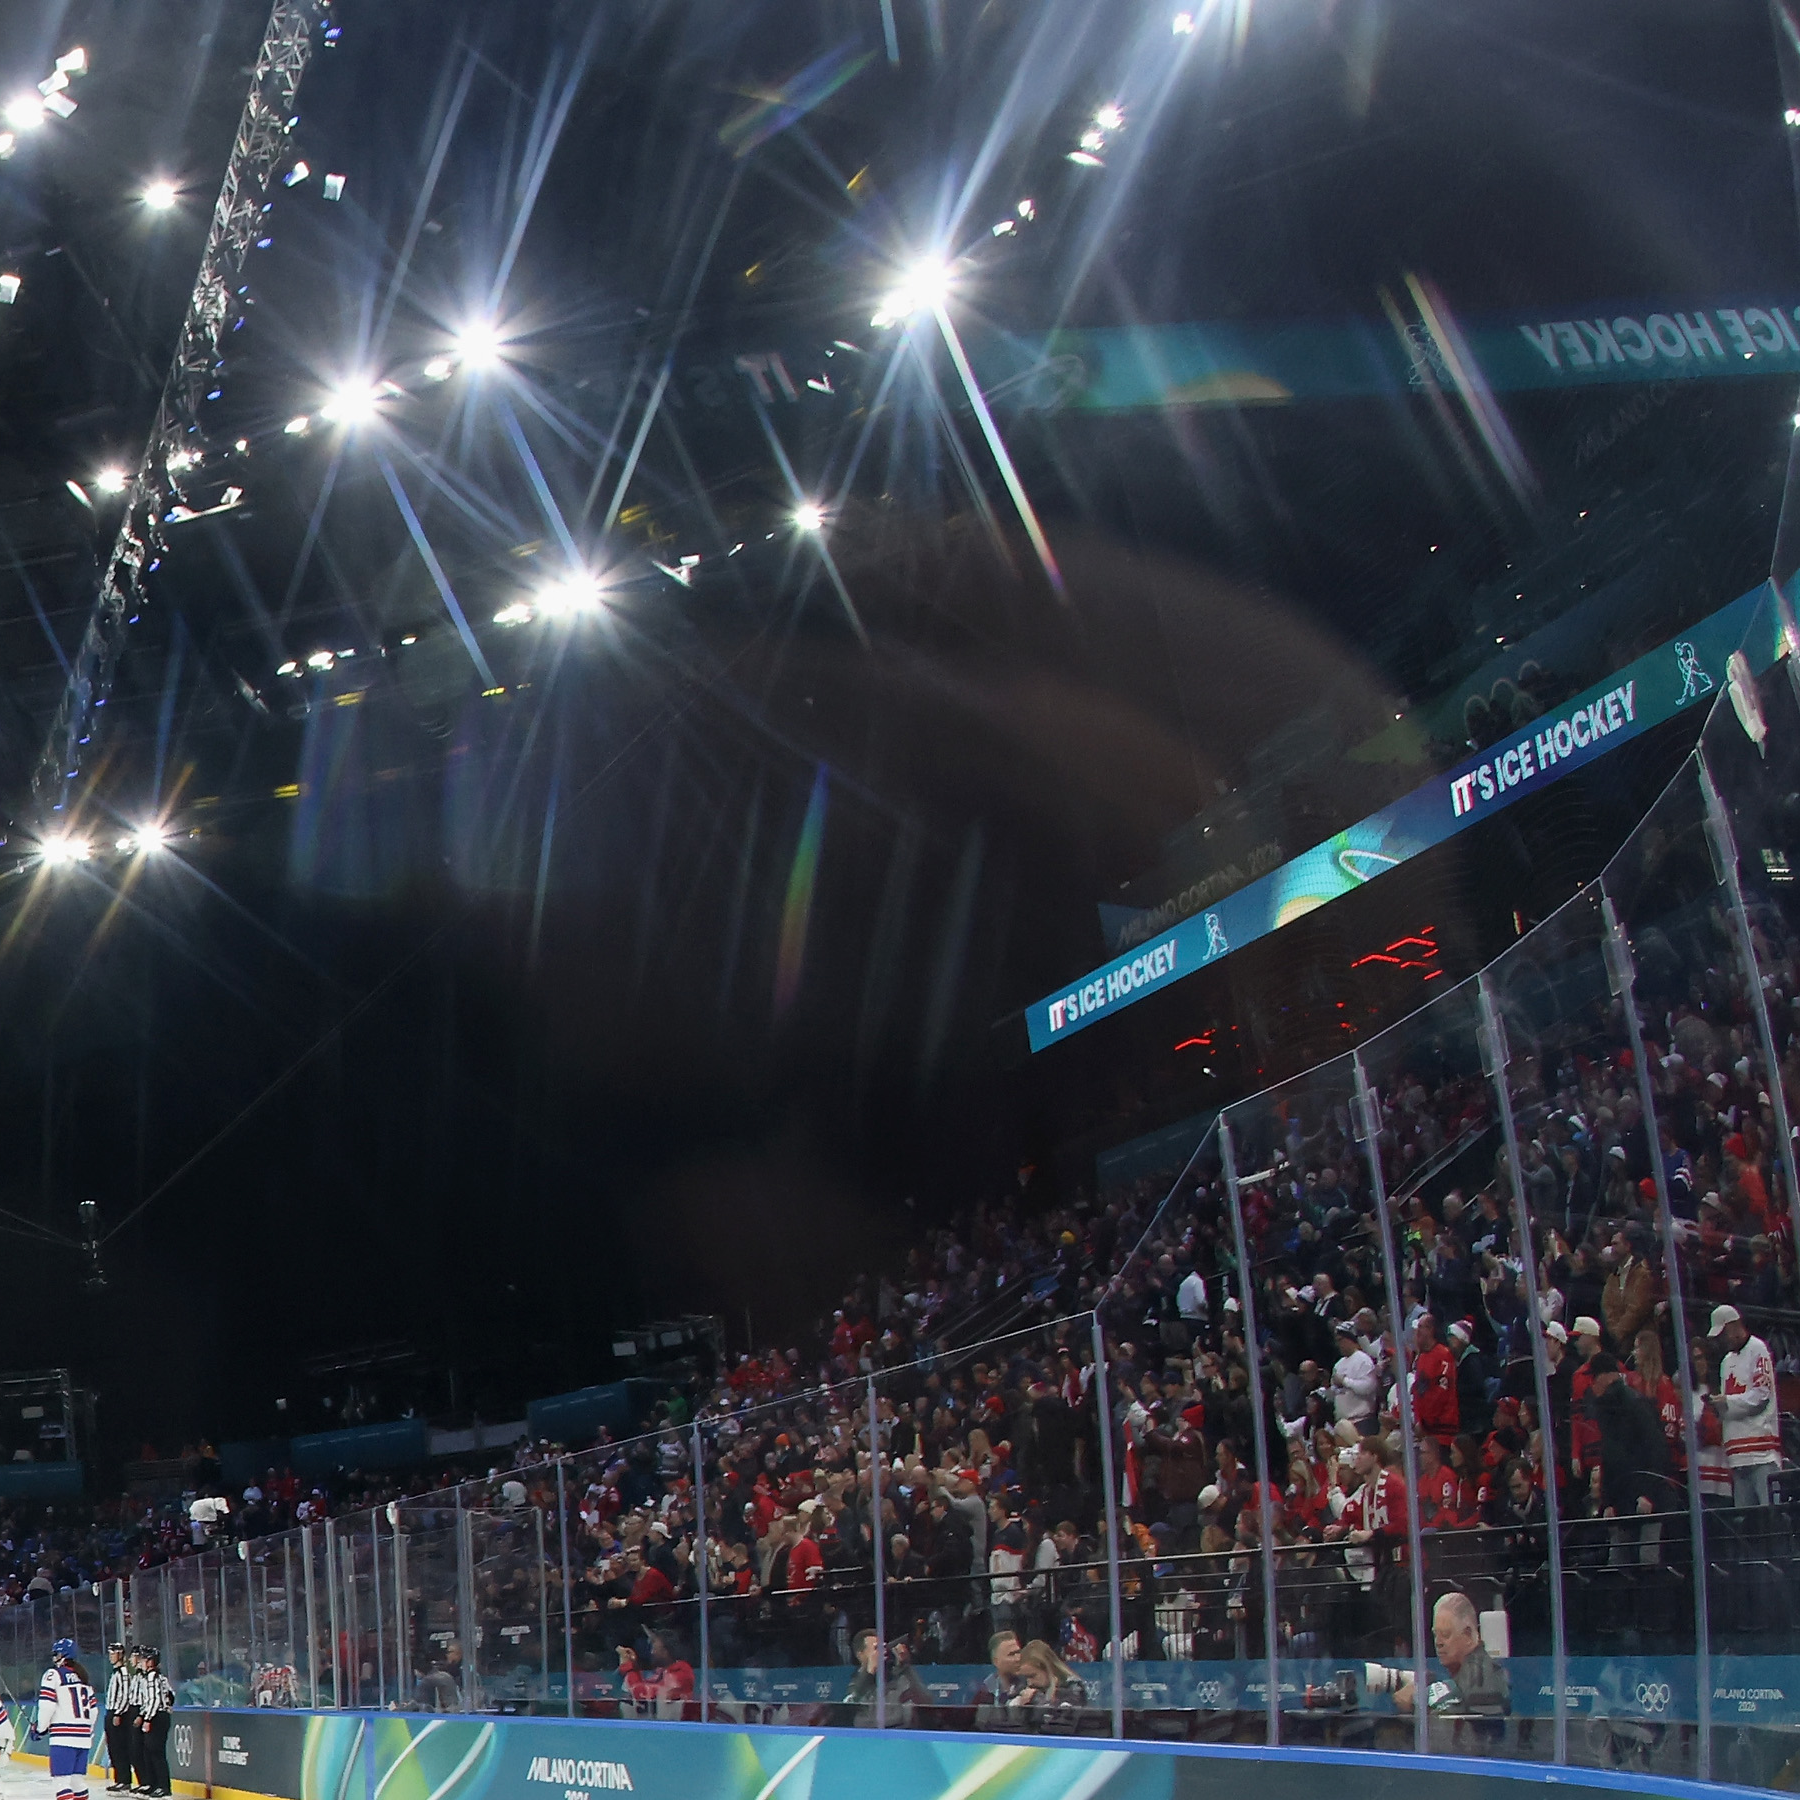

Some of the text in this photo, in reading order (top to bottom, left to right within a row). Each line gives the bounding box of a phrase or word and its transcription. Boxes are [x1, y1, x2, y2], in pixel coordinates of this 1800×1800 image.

[1451, 680, 1637, 818] IT'S ICE HOCKEY
[1048, 939, 1178, 1033] IT'S ICE HOCKEY
[1713, 1688, 1785, 1700] MILANO CORTINA
[526, 1756, 634, 1791] MILANO CORTINA
